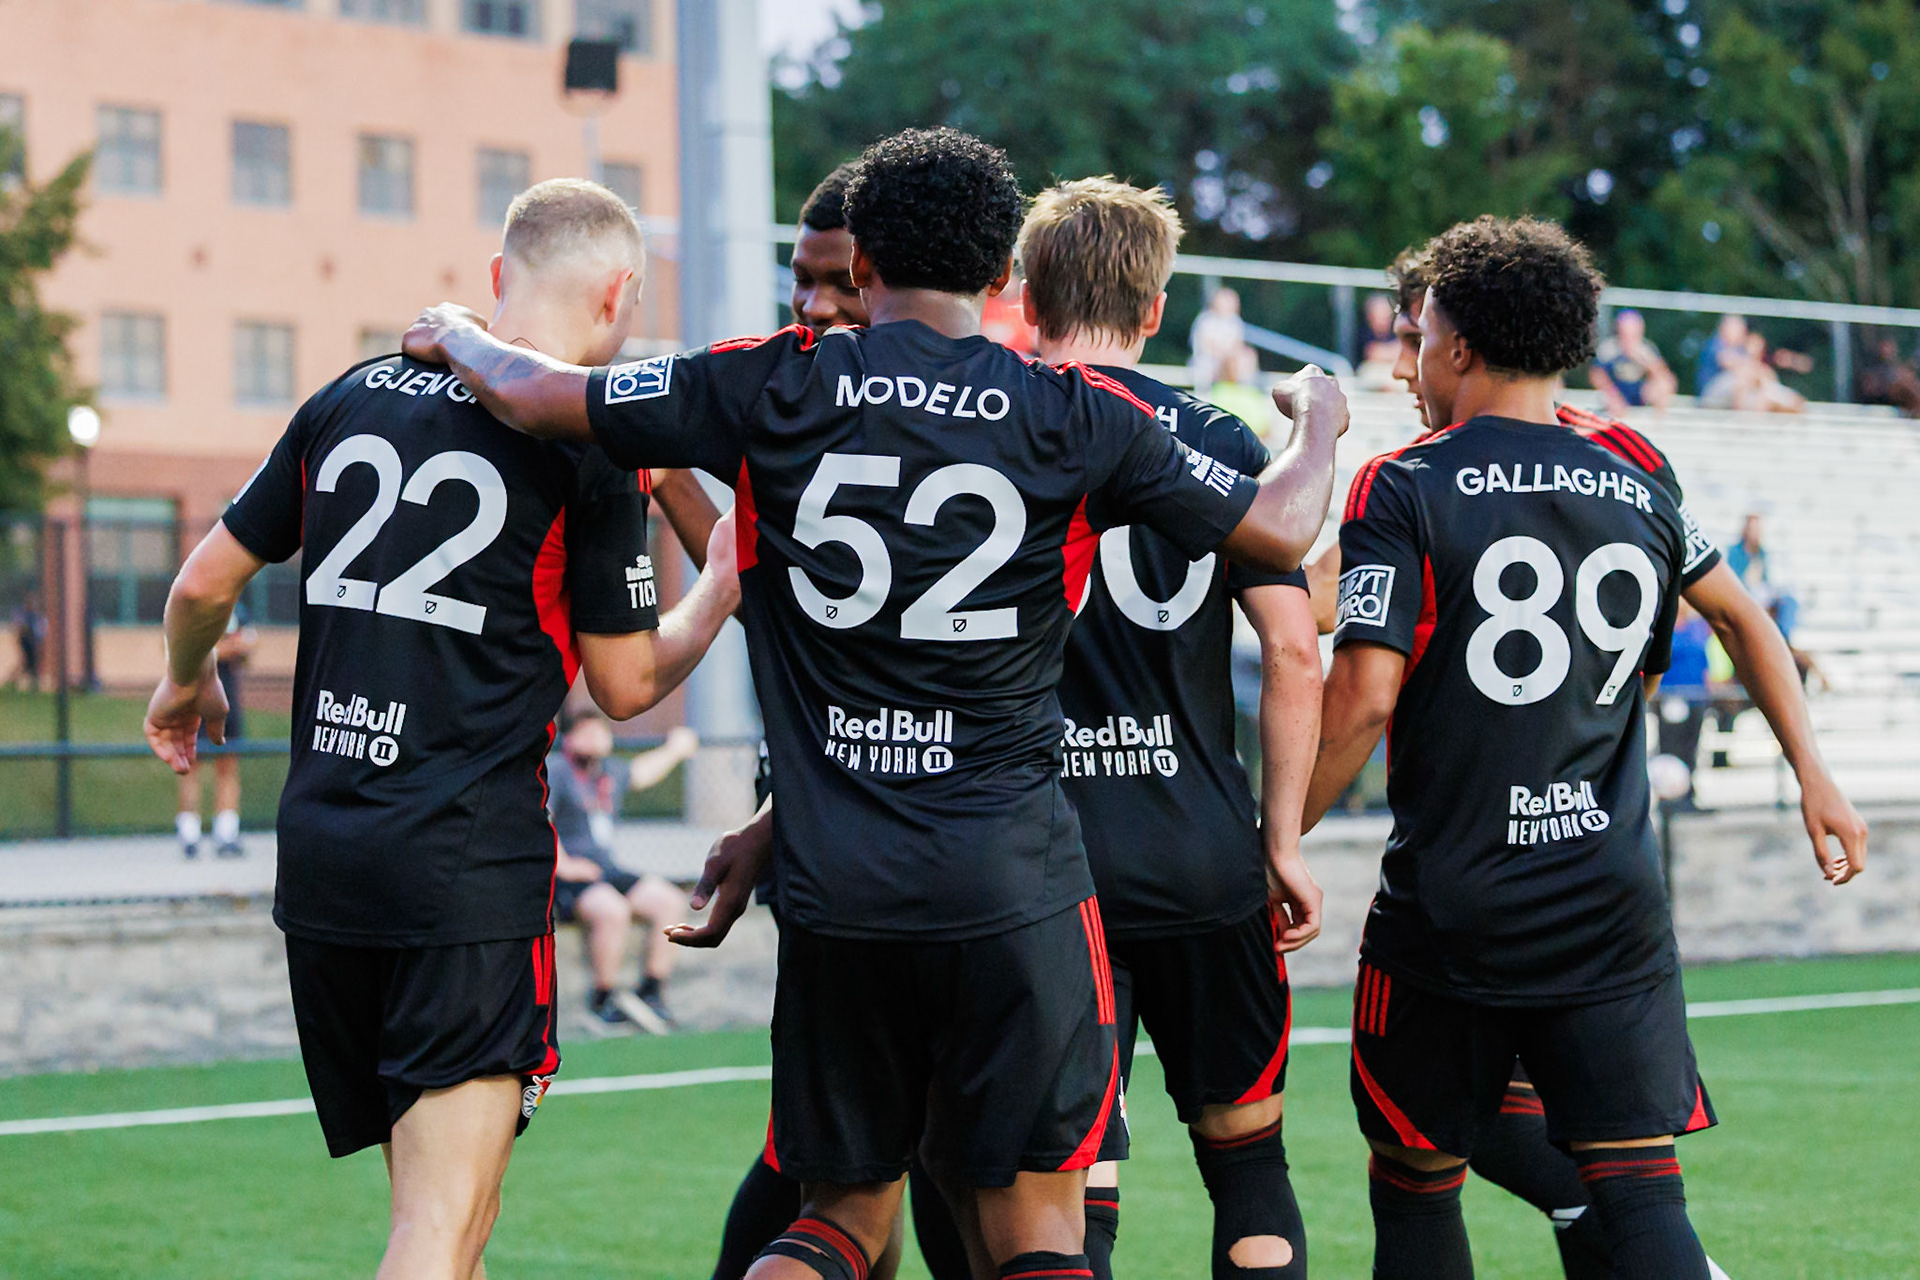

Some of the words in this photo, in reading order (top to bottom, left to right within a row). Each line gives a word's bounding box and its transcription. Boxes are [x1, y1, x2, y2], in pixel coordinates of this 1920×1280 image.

[365, 366, 477, 404] GJENG
[1456, 463, 1653, 513] GALLAGHER
[306, 433, 507, 635] 22
[788, 453, 1028, 641] 52
[1465, 535, 1659, 706] 89
[316, 690, 356, 724] Red
[351, 696, 407, 735] Bull
[828, 705, 888, 740] Red
[892, 709, 953, 743] Bull
[1060, 715, 1117, 748] Red
[1118, 714, 1173, 747] Bull
[825, 739, 861, 770] NEW
[869, 746, 917, 774] YORK
[1102, 749, 1151, 777] YORK
[1507, 820, 1540, 845] NEW
